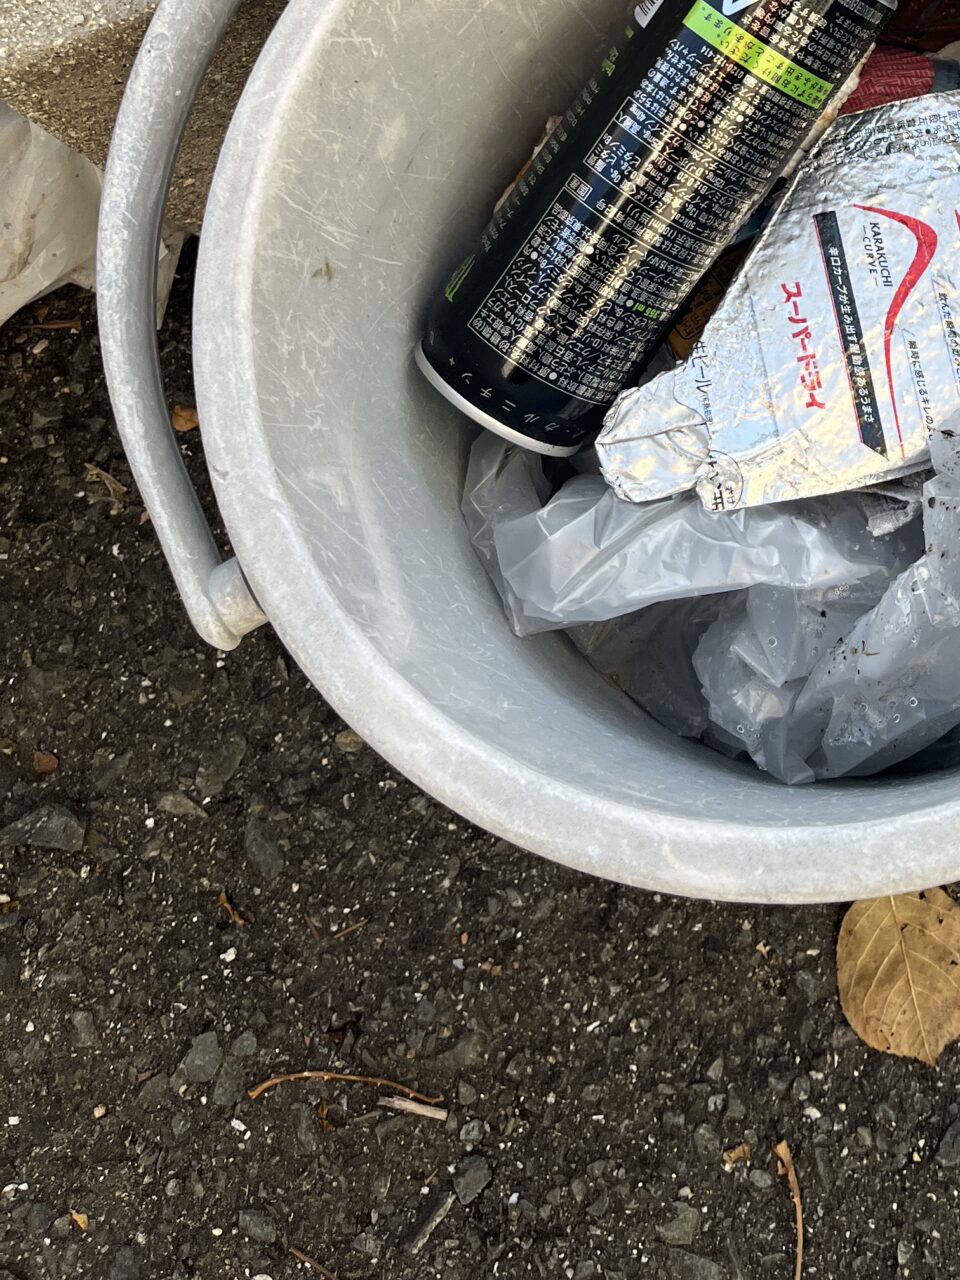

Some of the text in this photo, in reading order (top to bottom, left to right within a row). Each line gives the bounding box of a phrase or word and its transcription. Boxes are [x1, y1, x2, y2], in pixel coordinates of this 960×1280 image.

[568, 175, 589, 197] 国産
[869, 220, 893, 288] KARAKUCHI
[779, 279, 827, 412] スーパードライ
